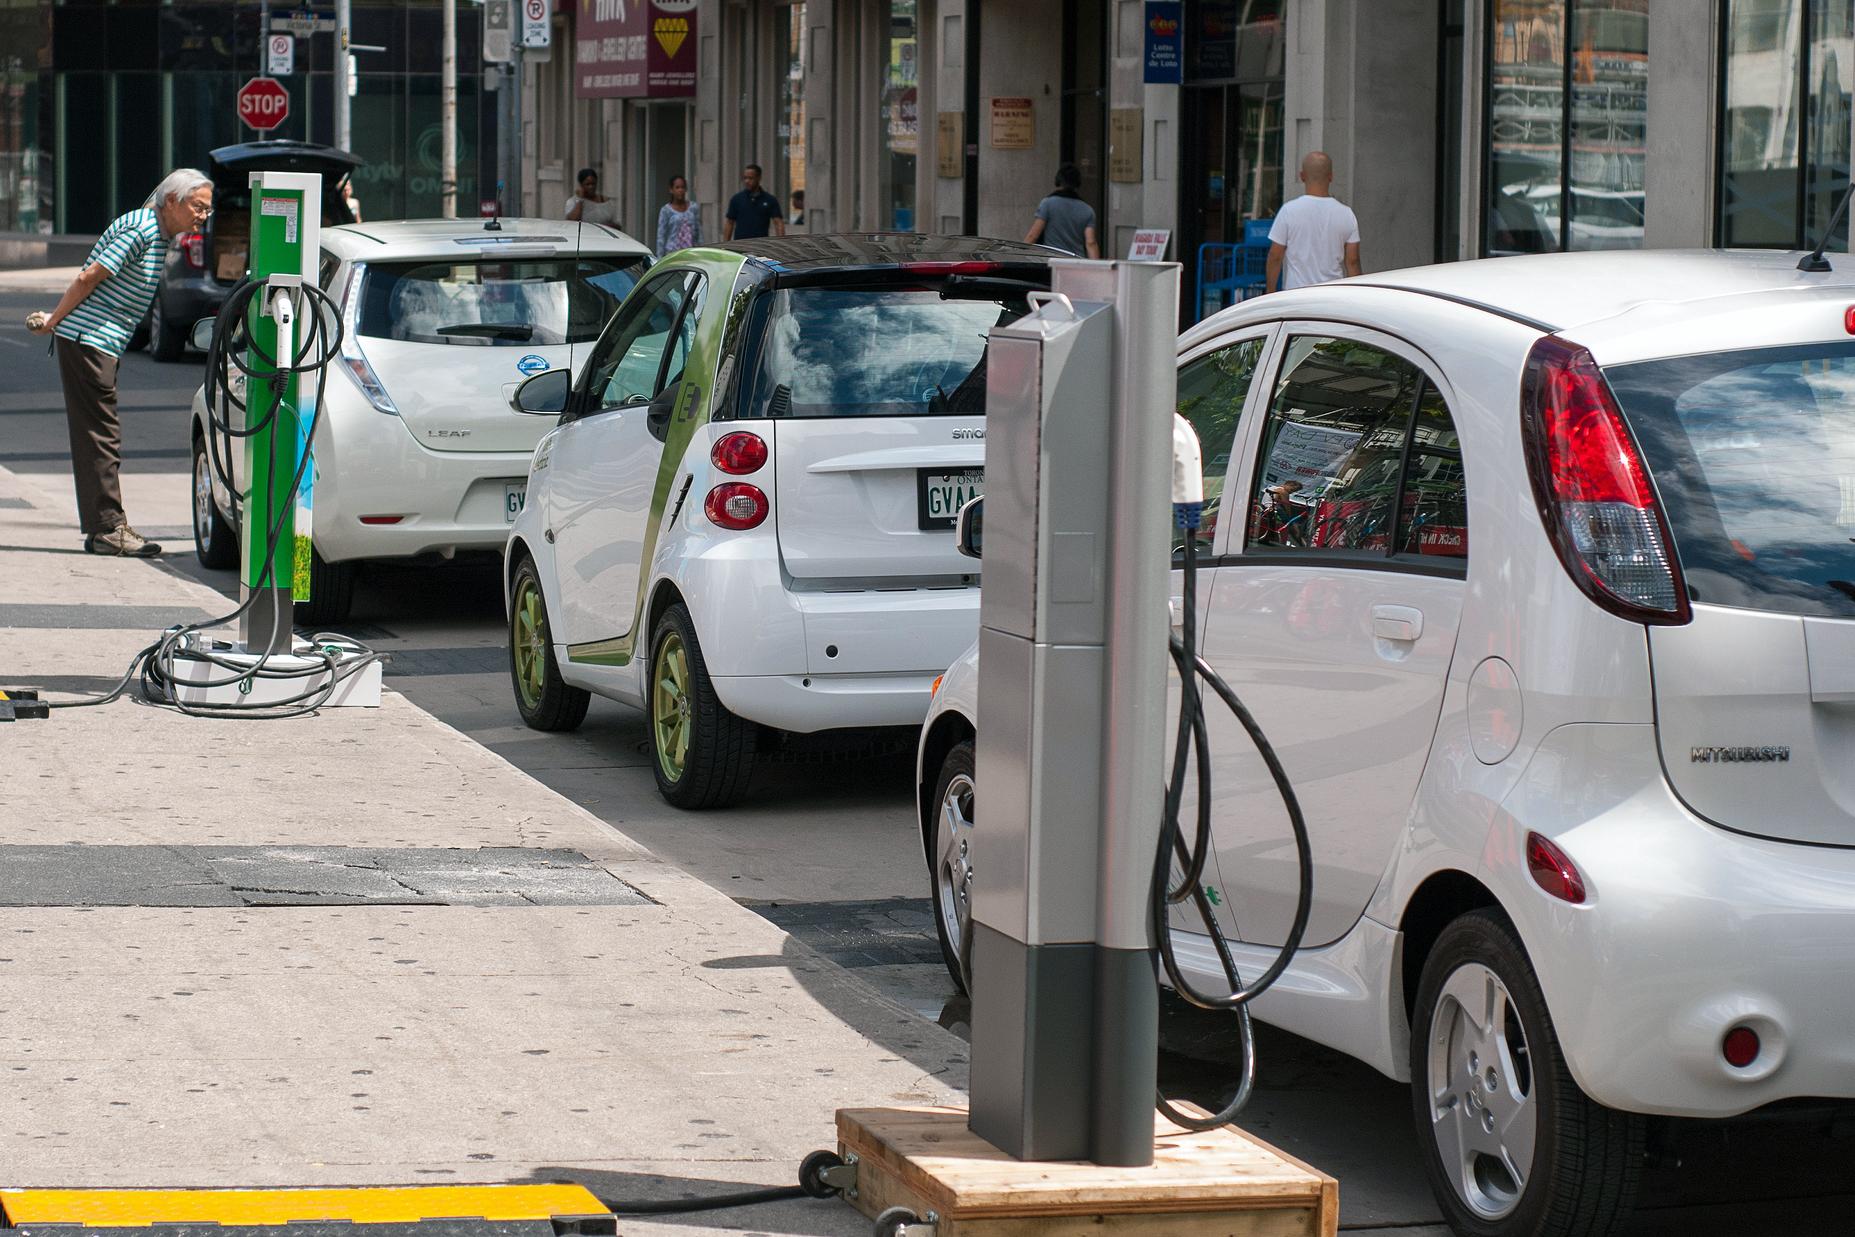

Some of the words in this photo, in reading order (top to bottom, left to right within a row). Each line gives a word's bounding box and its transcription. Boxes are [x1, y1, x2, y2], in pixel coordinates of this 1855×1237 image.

[1153, 43, 1174, 51] Lotto
[1151, 51, 1176, 59] Centre
[241, 94, 286, 115] STOP
[428, 429, 472, 438] LEAF
[952, 428, 987, 440] sma
[1690, 746, 1791, 763] MITSUBISHI
